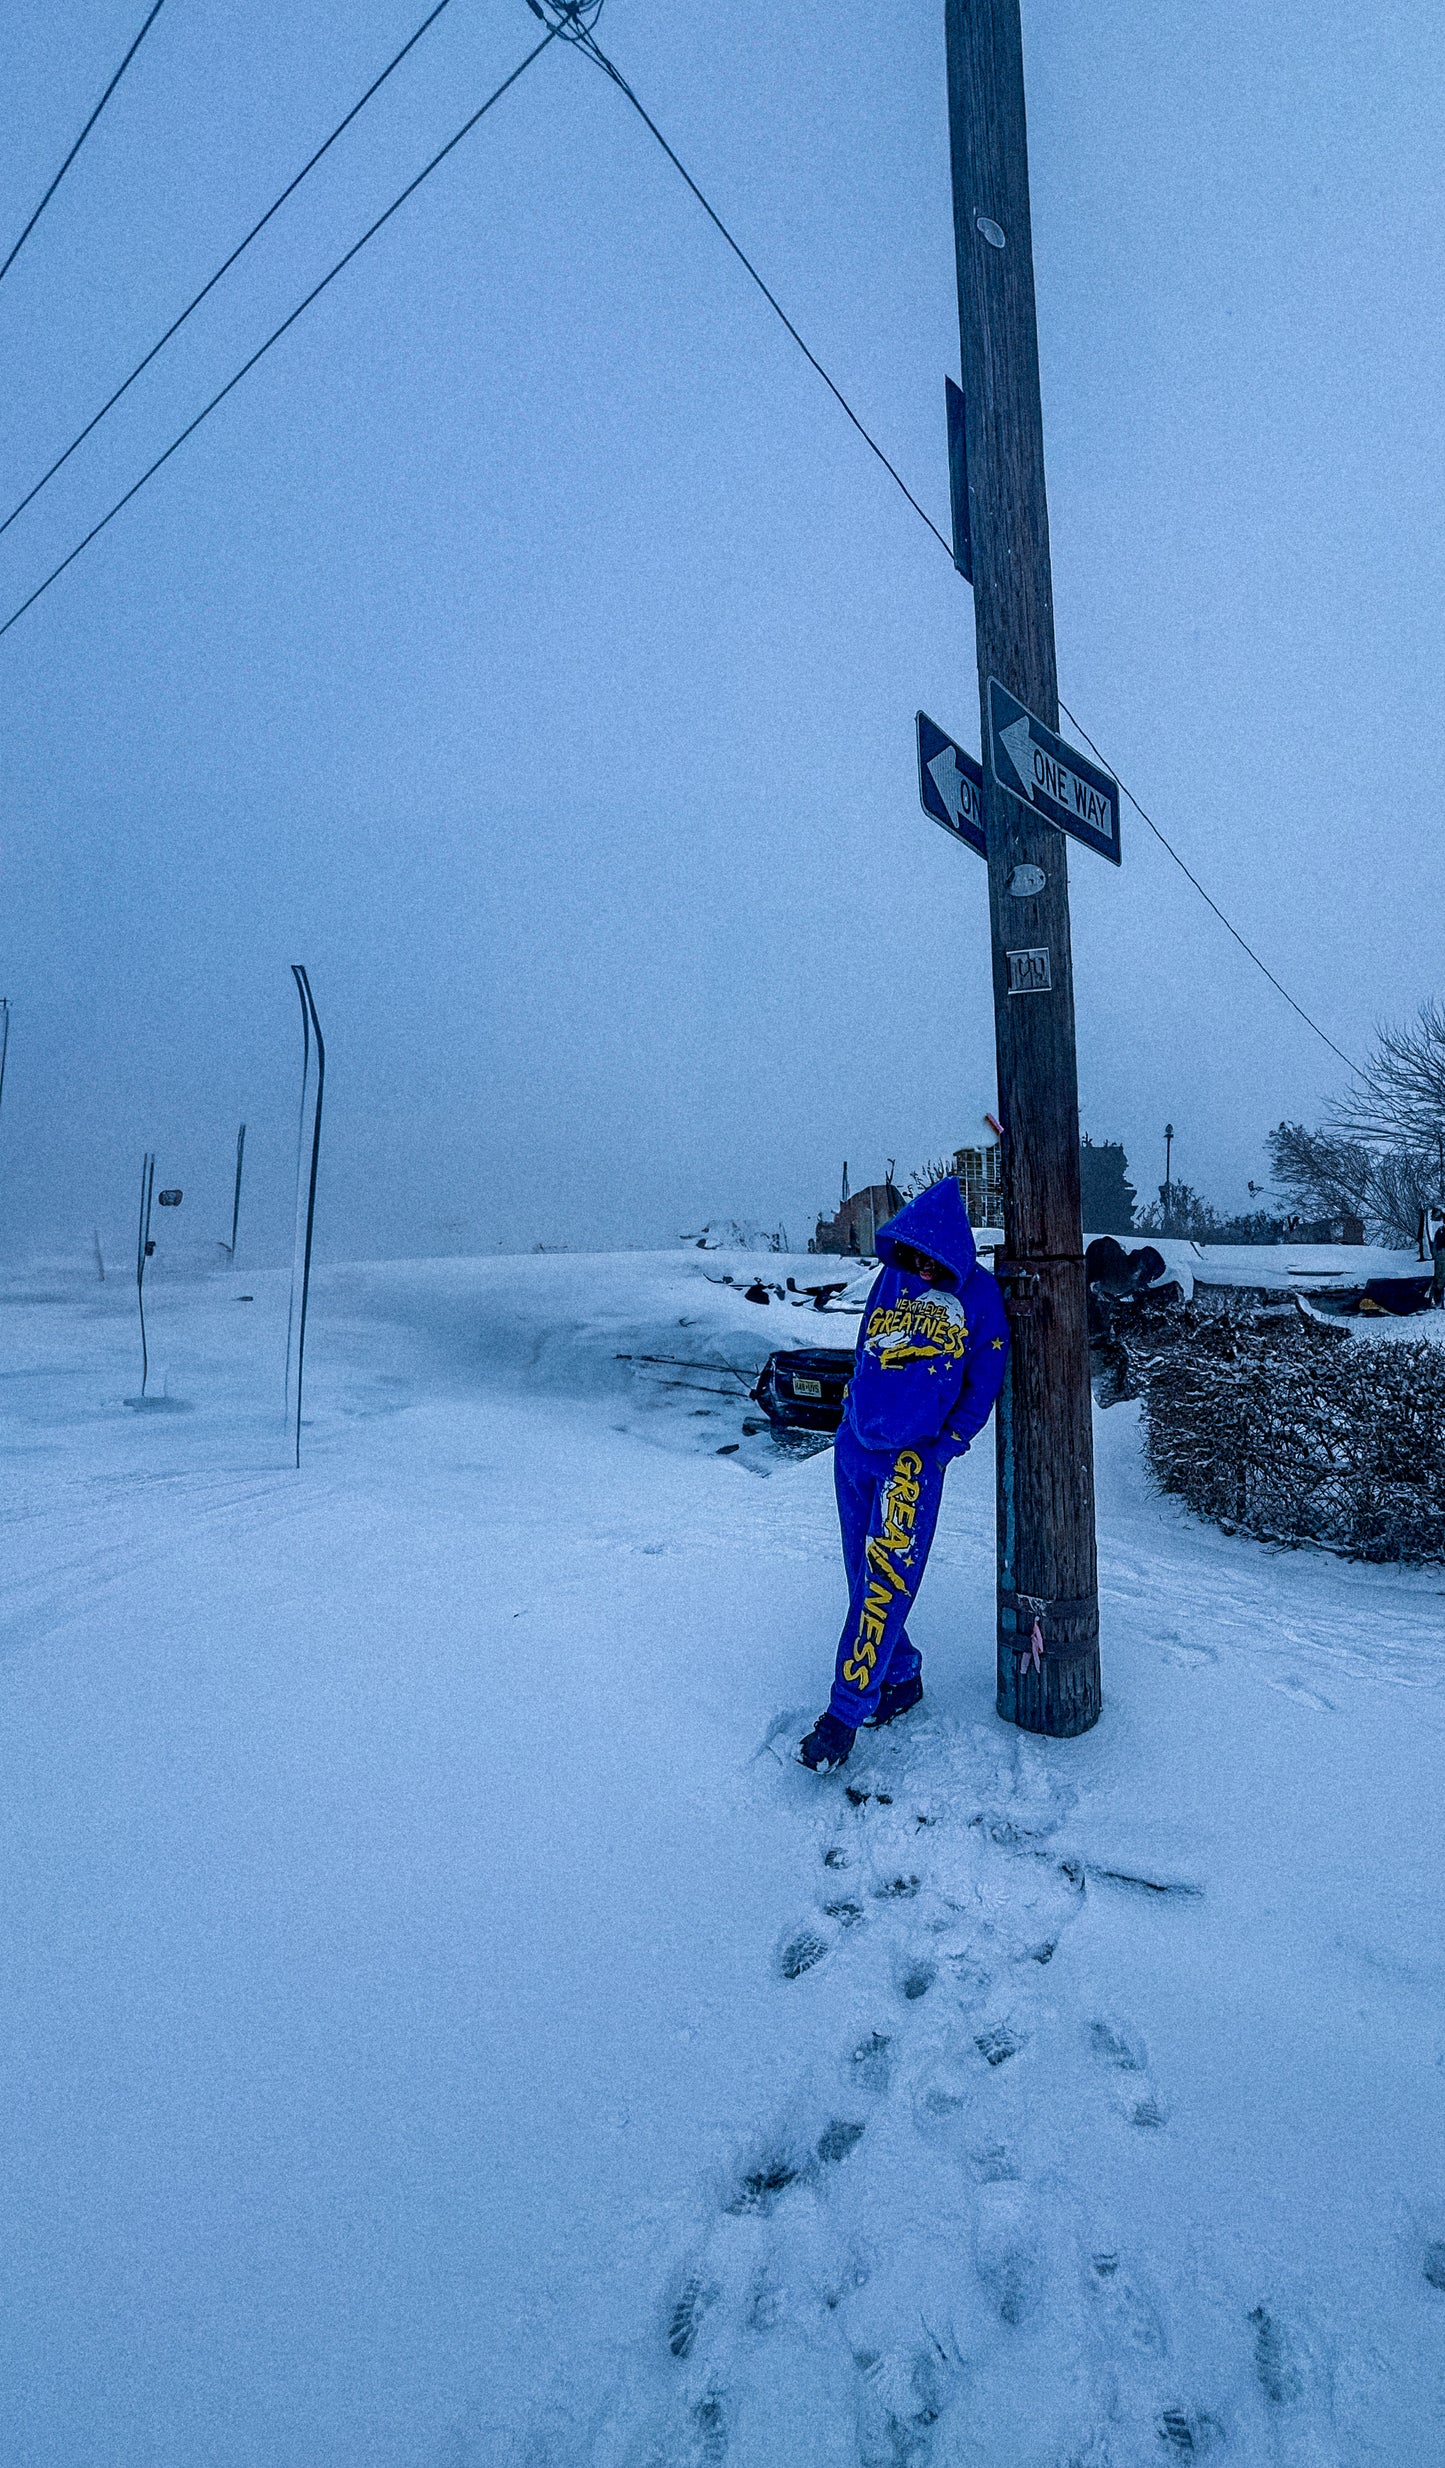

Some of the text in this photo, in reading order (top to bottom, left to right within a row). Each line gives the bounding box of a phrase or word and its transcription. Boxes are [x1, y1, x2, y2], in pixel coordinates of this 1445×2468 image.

[961, 780, 982, 822] ON
[1034, 749, 1107, 828] ONE WAY
[868, 1308, 968, 1357] GREATNESS
[896, 1298, 947, 1318] NEXT LEVEL
[843, 1450, 922, 1690] GREANESS
